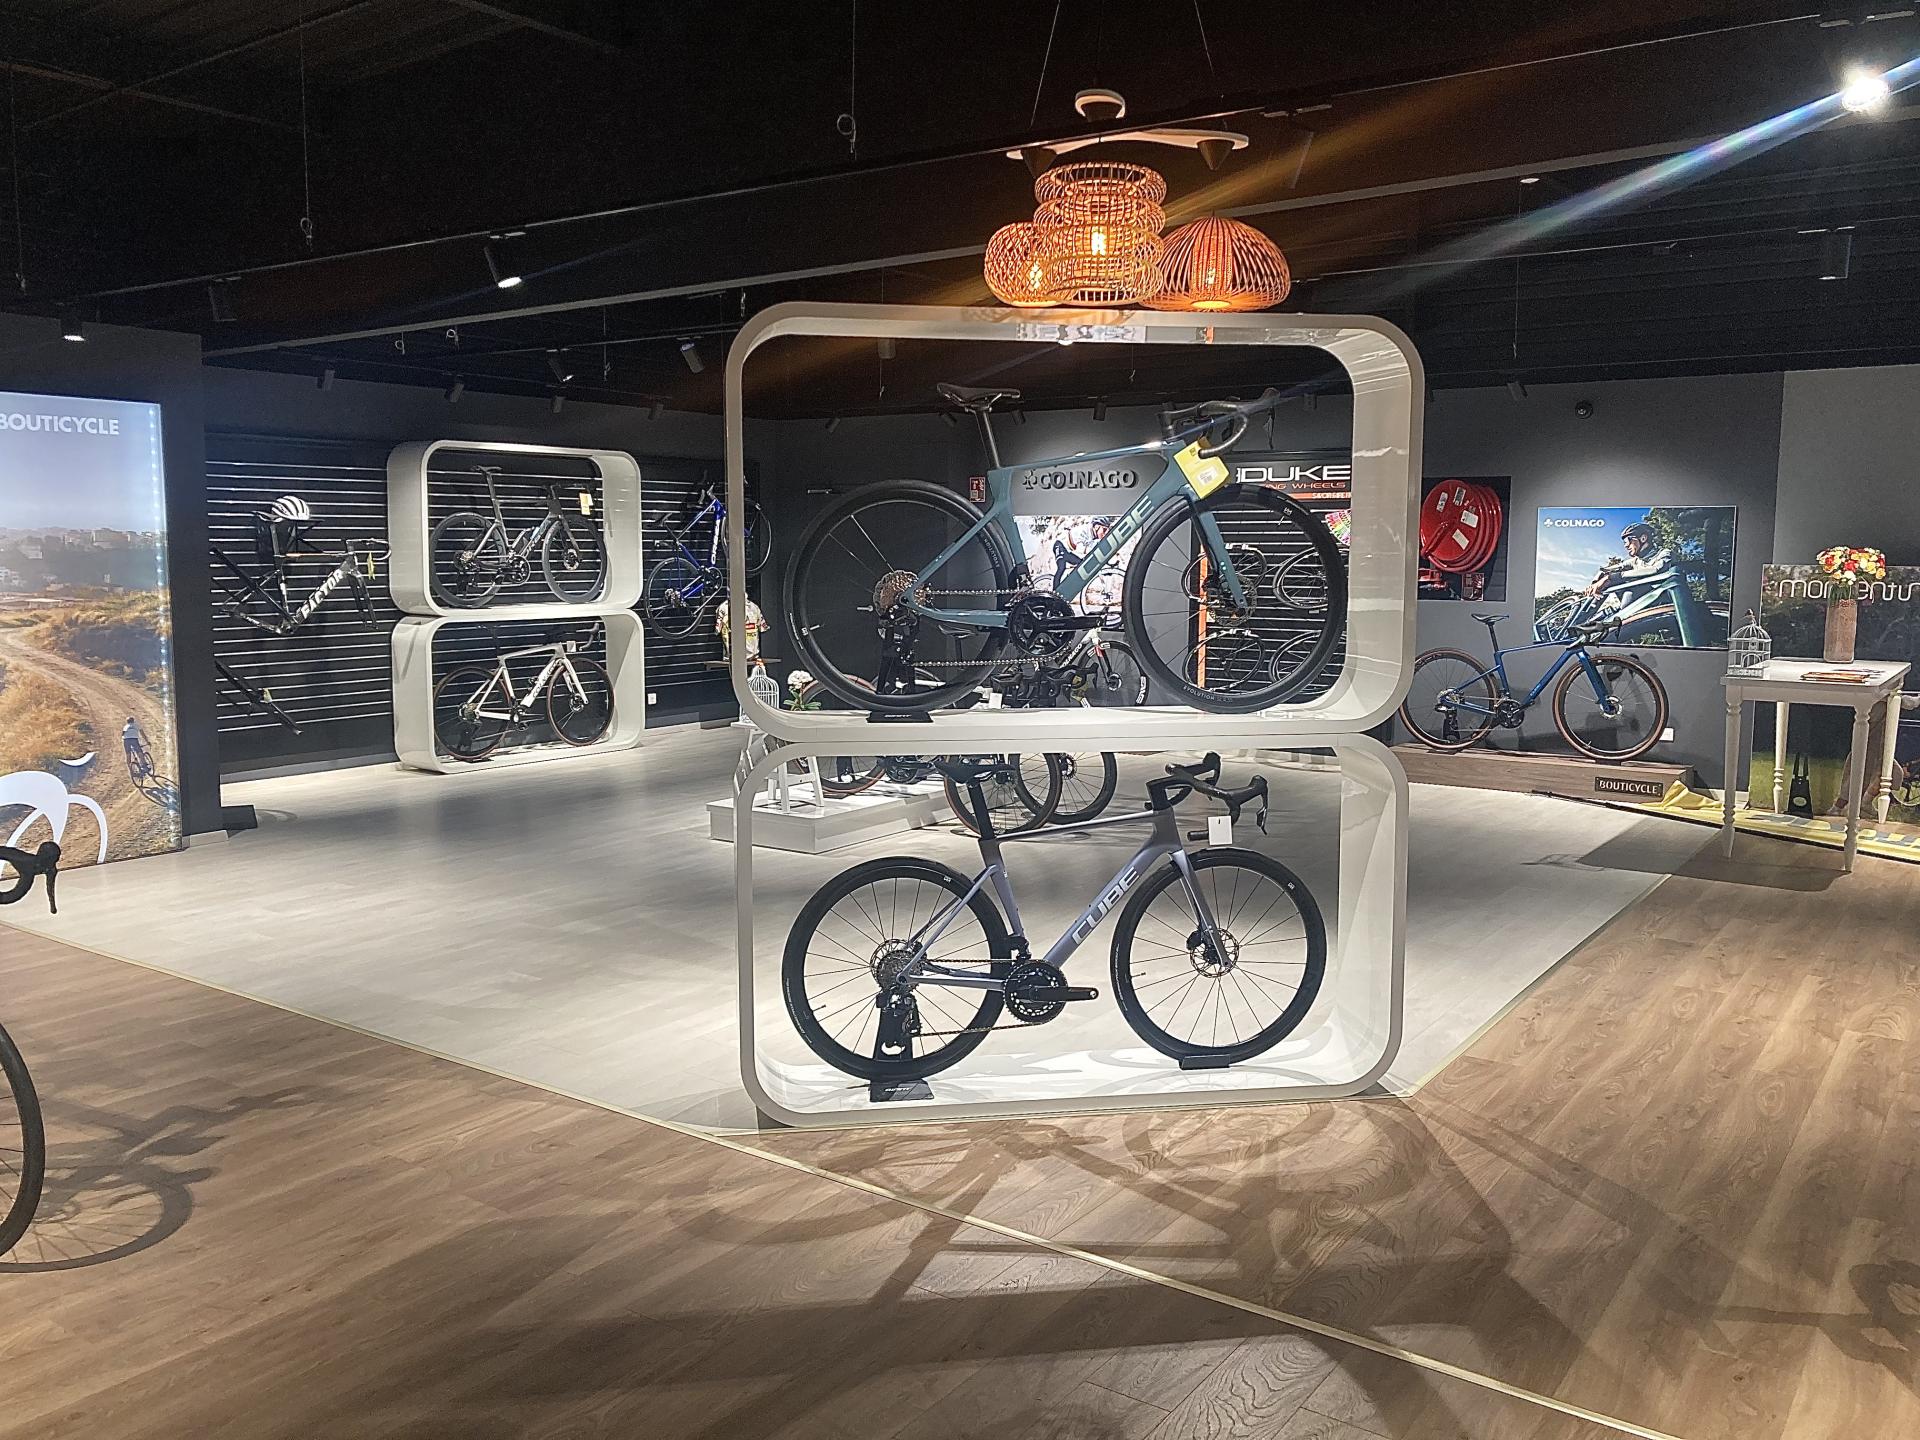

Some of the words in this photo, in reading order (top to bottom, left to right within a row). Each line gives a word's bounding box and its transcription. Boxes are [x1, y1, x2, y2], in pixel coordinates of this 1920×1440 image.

[0, 413, 120, 435] BOUTICYCLE
[1040, 470, 1138, 489] COLNAGO
[1240, 464, 1351, 483] DUKE
[1291, 481, 1346, 489] WHEELS
[1554, 519, 1605, 527] COLNAGO
[1077, 495, 1156, 581] CUBE
[300, 568, 344, 620] FACTOR
[1778, 579, 1920, 601] moentu
[1182, 685, 1215, 701] EVOLUTION
[1599, 780, 1659, 795] BOUTICYCLE
[1072, 866, 1140, 945] CUBE
